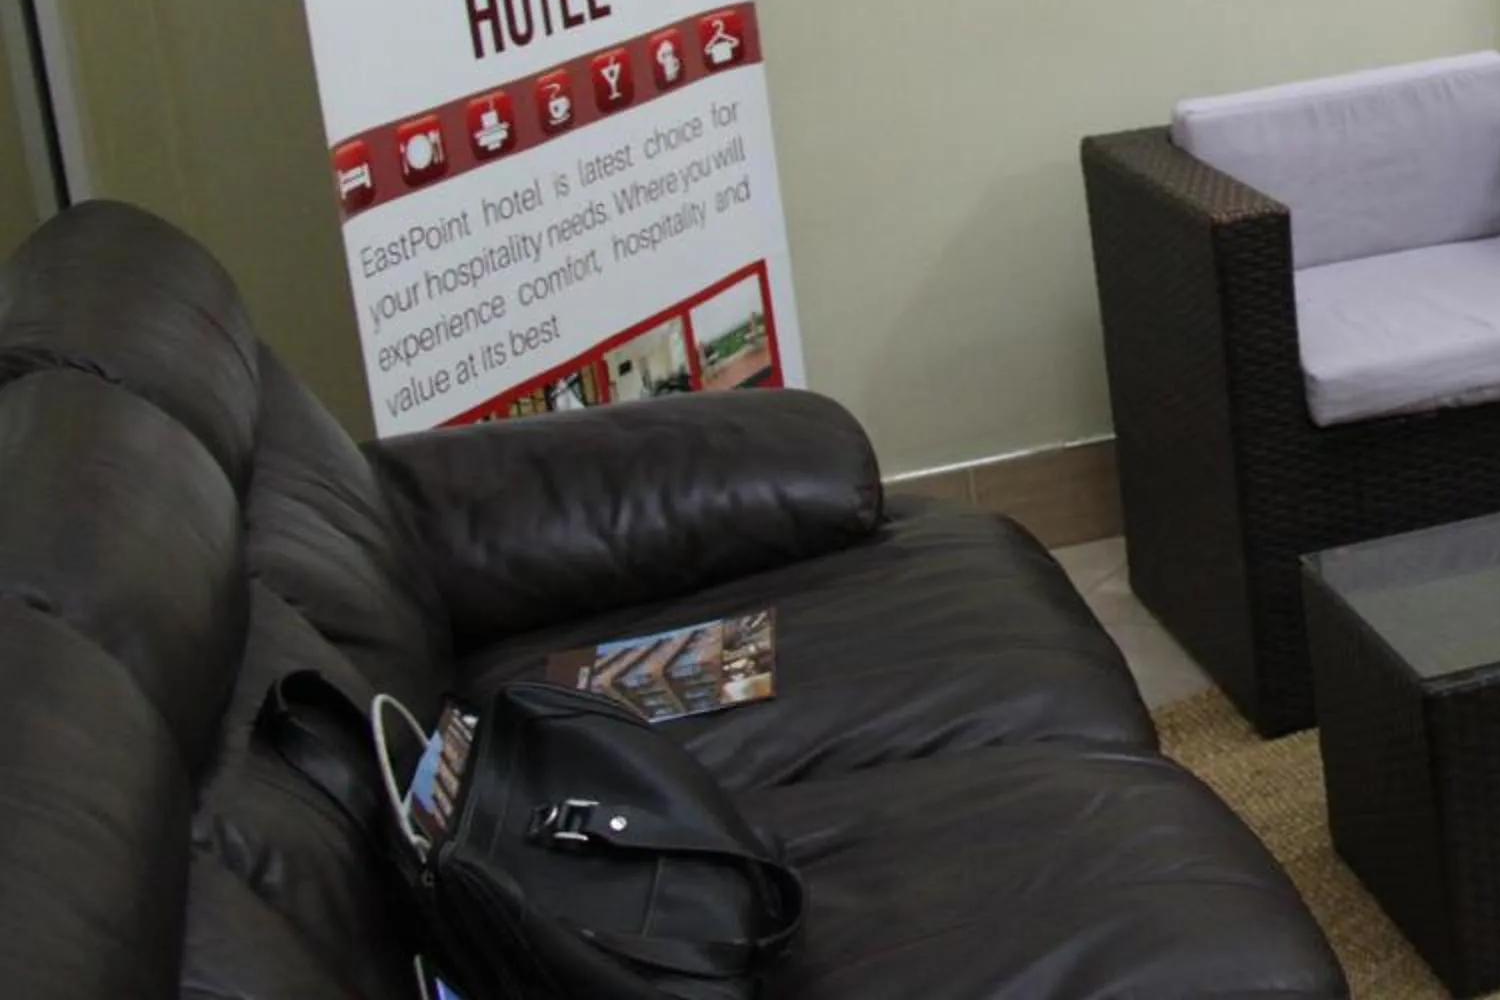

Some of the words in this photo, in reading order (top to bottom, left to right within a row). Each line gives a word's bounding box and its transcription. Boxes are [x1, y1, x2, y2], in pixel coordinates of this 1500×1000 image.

[360, 211, 471, 279] EastPoint
[482, 178, 544, 227] hotel
[553, 172, 571, 198] is
[578, 145, 634, 187] latest
[643, 117, 703, 160] choice
[711, 101, 739, 129] for
[369, 281, 420, 335] your
[424, 231, 542, 293] hospitality
[612, 170, 678, 215] Where
[678, 156, 712, 193] you
[711, 135, 746, 170] will
[379, 295, 507, 372] experience
[611, 200, 707, 262] hospitality
[714, 174, 751, 214] and
[386, 369, 450, 418] value
[456, 353, 479, 386] at
[481, 343, 508, 374] its
[509, 314, 561, 357] best
